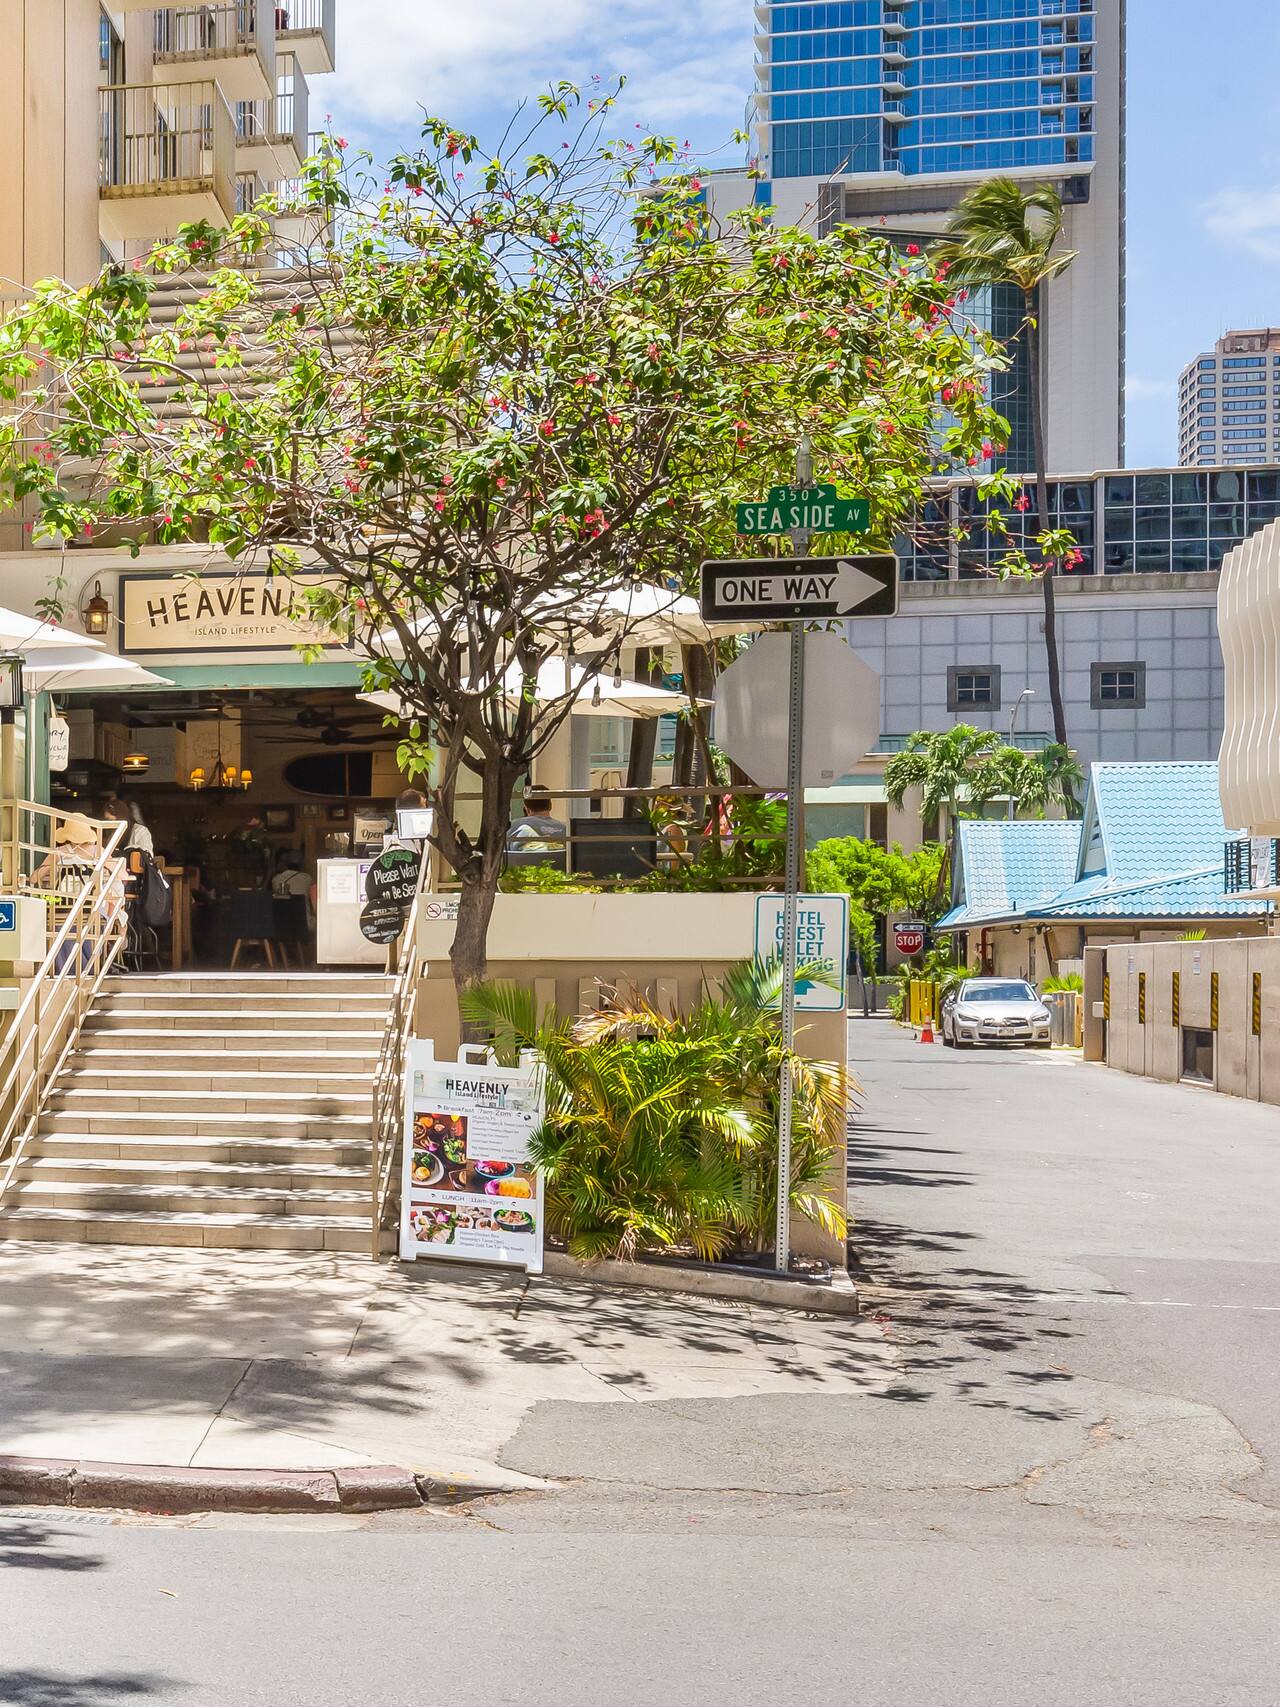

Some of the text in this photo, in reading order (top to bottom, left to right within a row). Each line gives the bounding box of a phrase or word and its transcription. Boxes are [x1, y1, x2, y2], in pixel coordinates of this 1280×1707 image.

[778, 490, 809, 502] 350
[847, 509, 860, 521] AV
[722, 576, 837, 603] ONE WAY
[194, 625, 276, 636] ISLAND LIFESTYLE
[373, 869, 400, 885] Please
[391, 885, 403, 899] Be
[401, 882, 417, 897] Sea
[776, 911, 826, 925] HTEL
[775, 926, 826, 941] GEST
[897, 935, 921, 946] STOP
[775, 941, 825, 956] VLET
[445, 1079, 509, 1095] HEAVENLY
